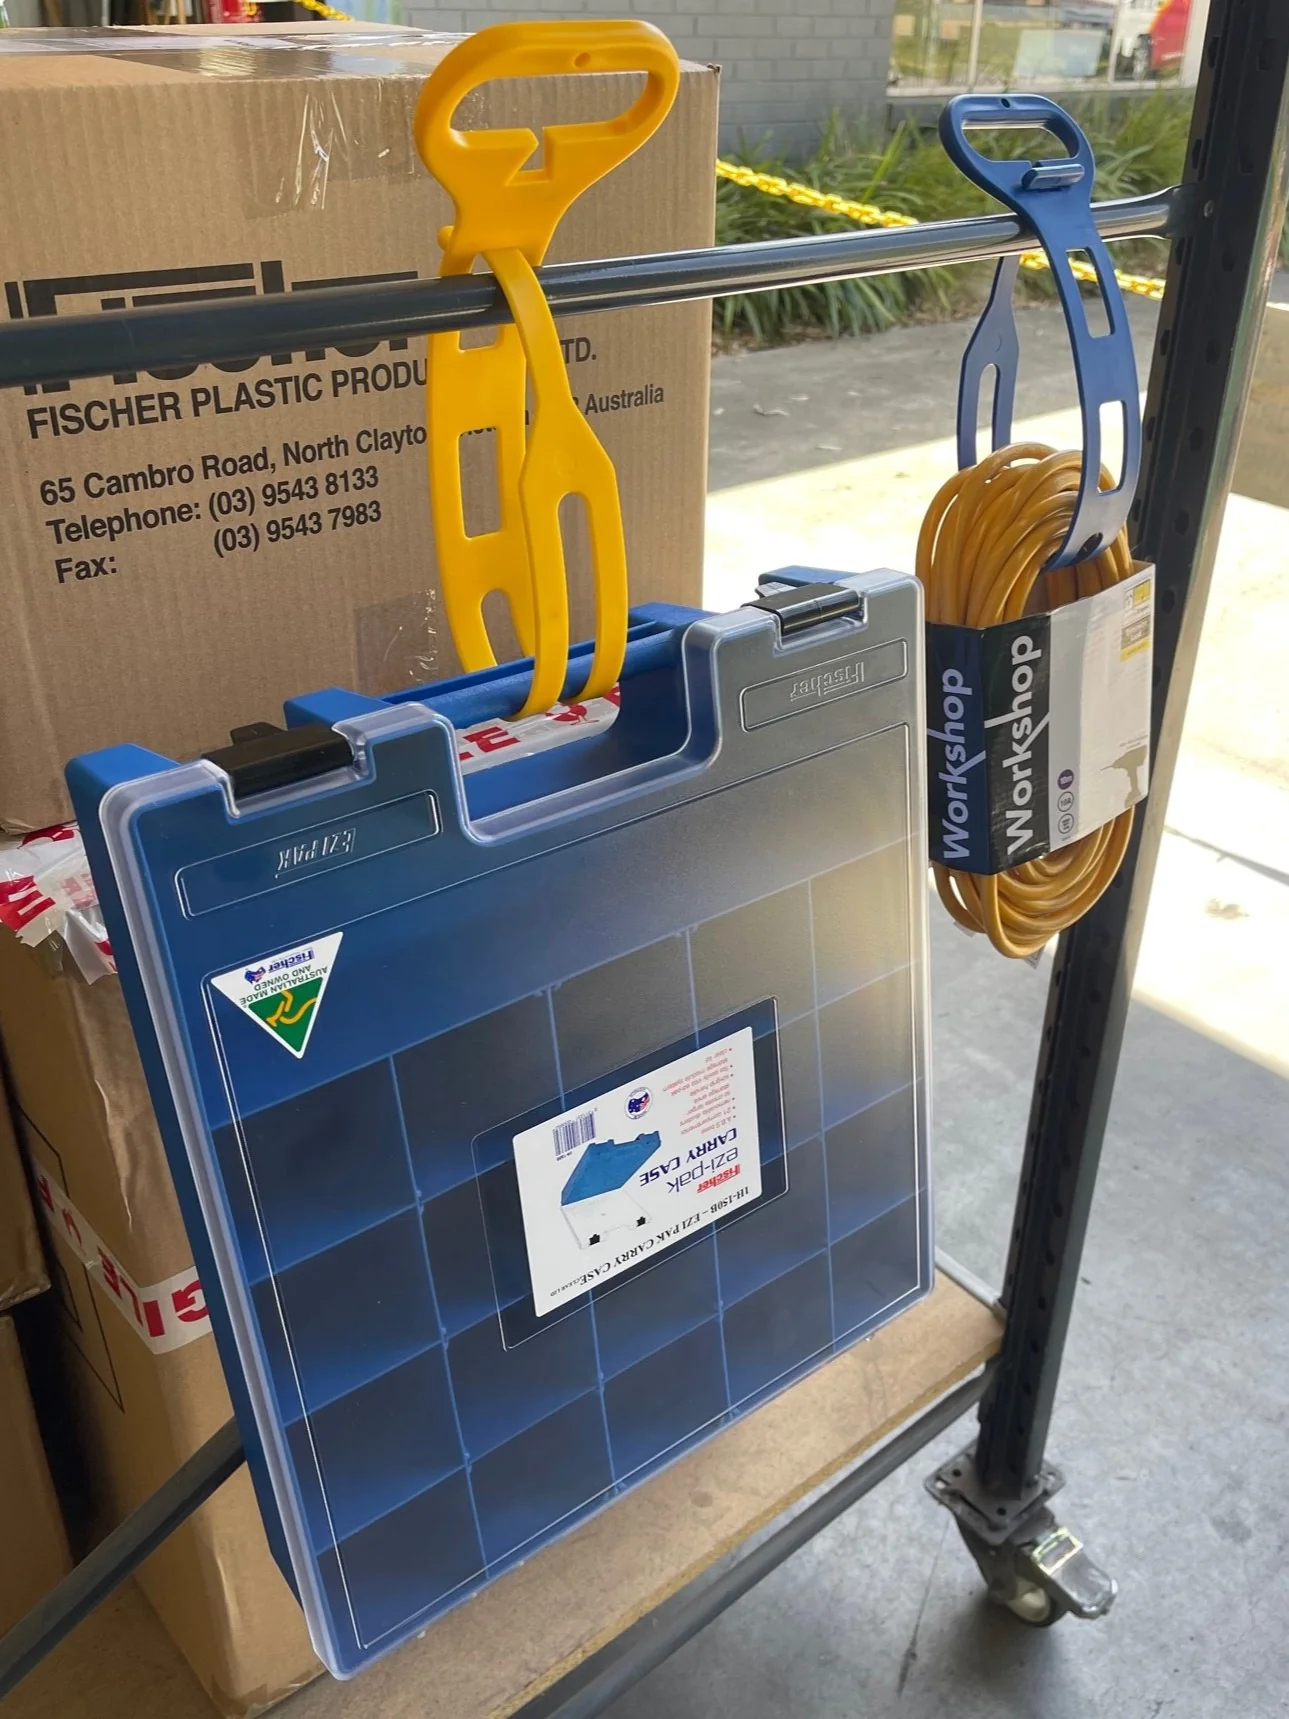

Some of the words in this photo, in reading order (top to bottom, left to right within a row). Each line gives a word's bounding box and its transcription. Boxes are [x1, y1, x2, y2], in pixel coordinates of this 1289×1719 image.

[26, 391, 182, 440] FISCHER
[191, 373, 323, 417] PLASTIC
[331, 358, 428, 398] PRODU
[559, 337, 597, 364] TD.
[40, 477, 76, 506] 65
[83, 464, 195, 499] Cambro
[201, 446, 277, 480] Road,
[282, 435, 350, 467] North
[356, 425, 428, 454] Clayto
[584, 384, 665, 415] Australia
[45, 502, 201, 545] Telephone:
[208, 486, 256, 522] (03)
[262, 476, 319, 507] 9543
[325, 465, 379, 495] 8133
[54, 556, 118, 584] Fax:
[214, 523, 260, 558] (03)
[266, 511, 322, 542] 9543
[327, 500, 382, 530] 7983
[984, 635, 1050, 856] Workshop
[927, 667, 986, 859] Workshop
[277, 839, 319, 871] PAK
[268, 949, 316, 974] Fischer
[291, 964, 312, 977] AND
[254, 973, 290, 991] OWNED
[270, 966, 328, 994] AUSTRALIAN
[239, 989, 268, 1005] MADE
[686, 1127, 738, 1163] CARRY
[639, 1156, 681, 1187] CASE
[666, 1147, 739, 1194] ezi-pak
[697, 1164, 741, 1193] Fischer
[710, 1186, 749, 1214] 1H-150B
[656, 1223, 680, 1244] PAK
[682, 1213, 701, 1230] EZI
[614, 1238, 655, 1268] CARRY
[579, 1262, 611, 1286] CASE
